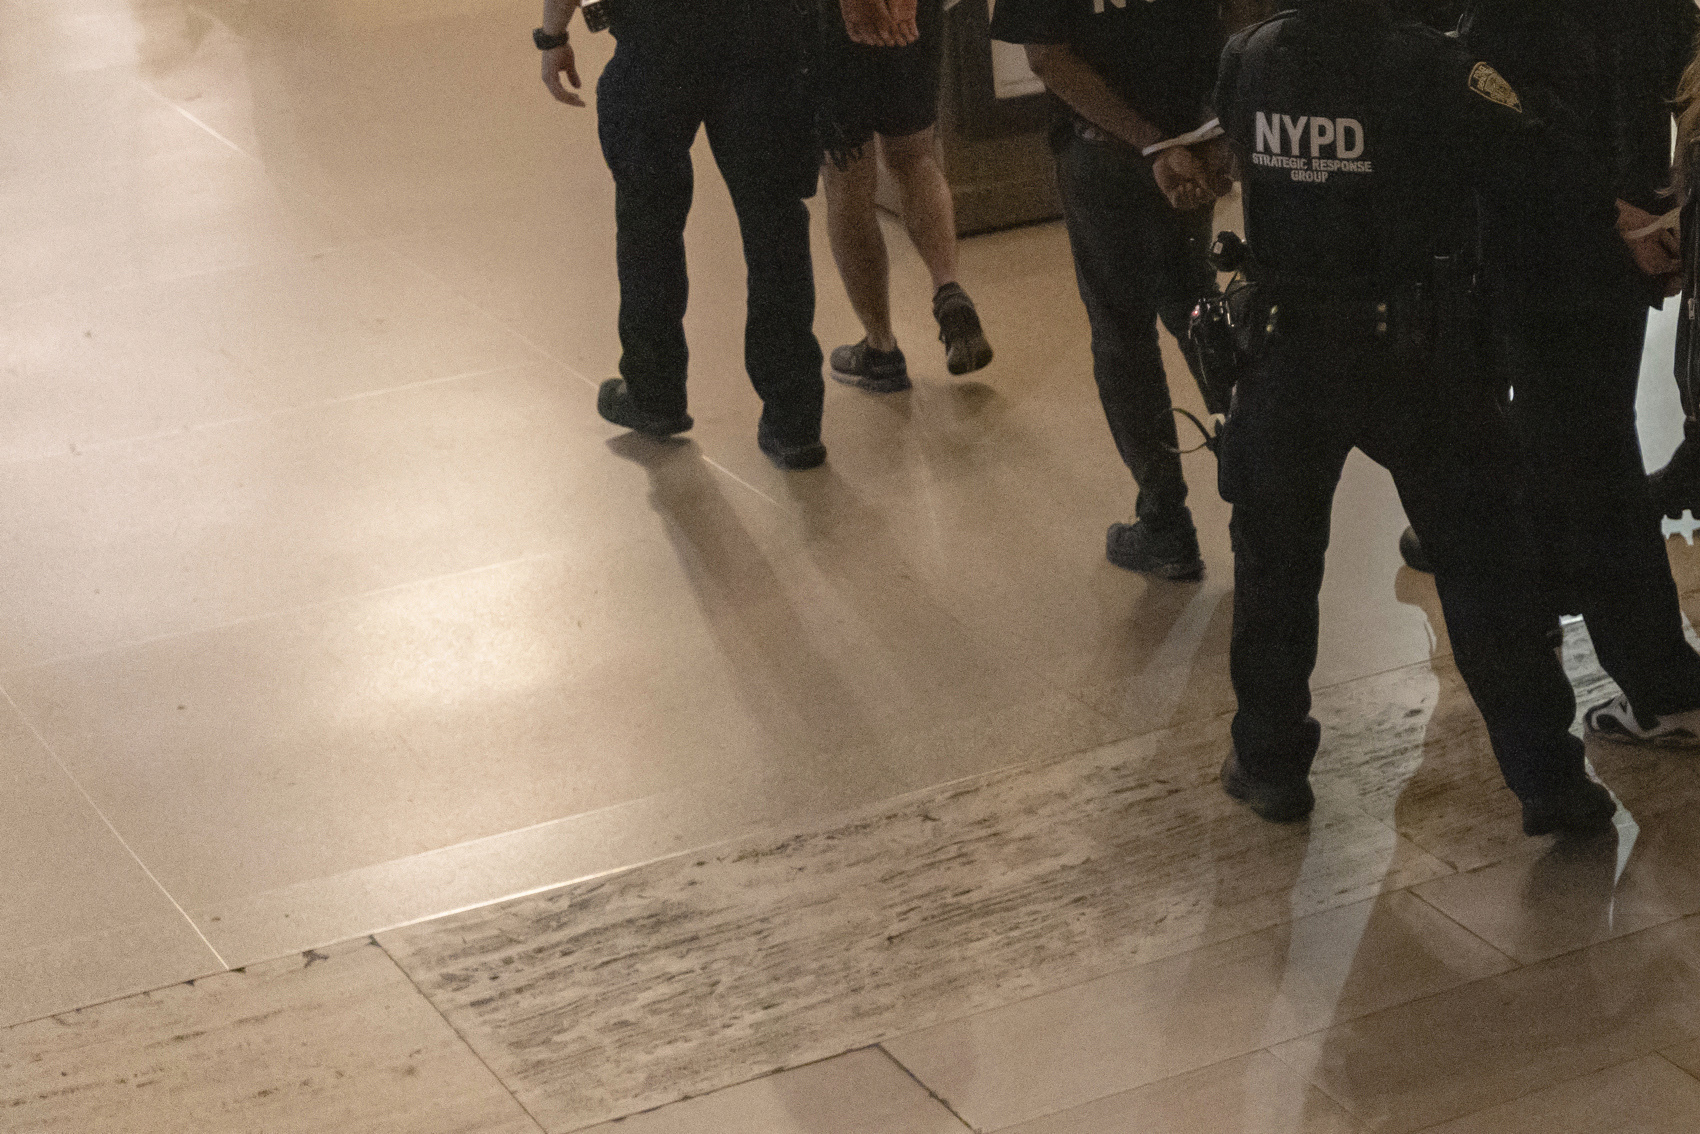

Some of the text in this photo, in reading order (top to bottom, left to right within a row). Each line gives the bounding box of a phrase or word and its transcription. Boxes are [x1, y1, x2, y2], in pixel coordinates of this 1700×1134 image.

[1254, 110, 1365, 160] NYPD
[1251, 152, 1374, 173] STRATEGIC RESPONSE
[1289, 169, 1329, 184] GROUP
